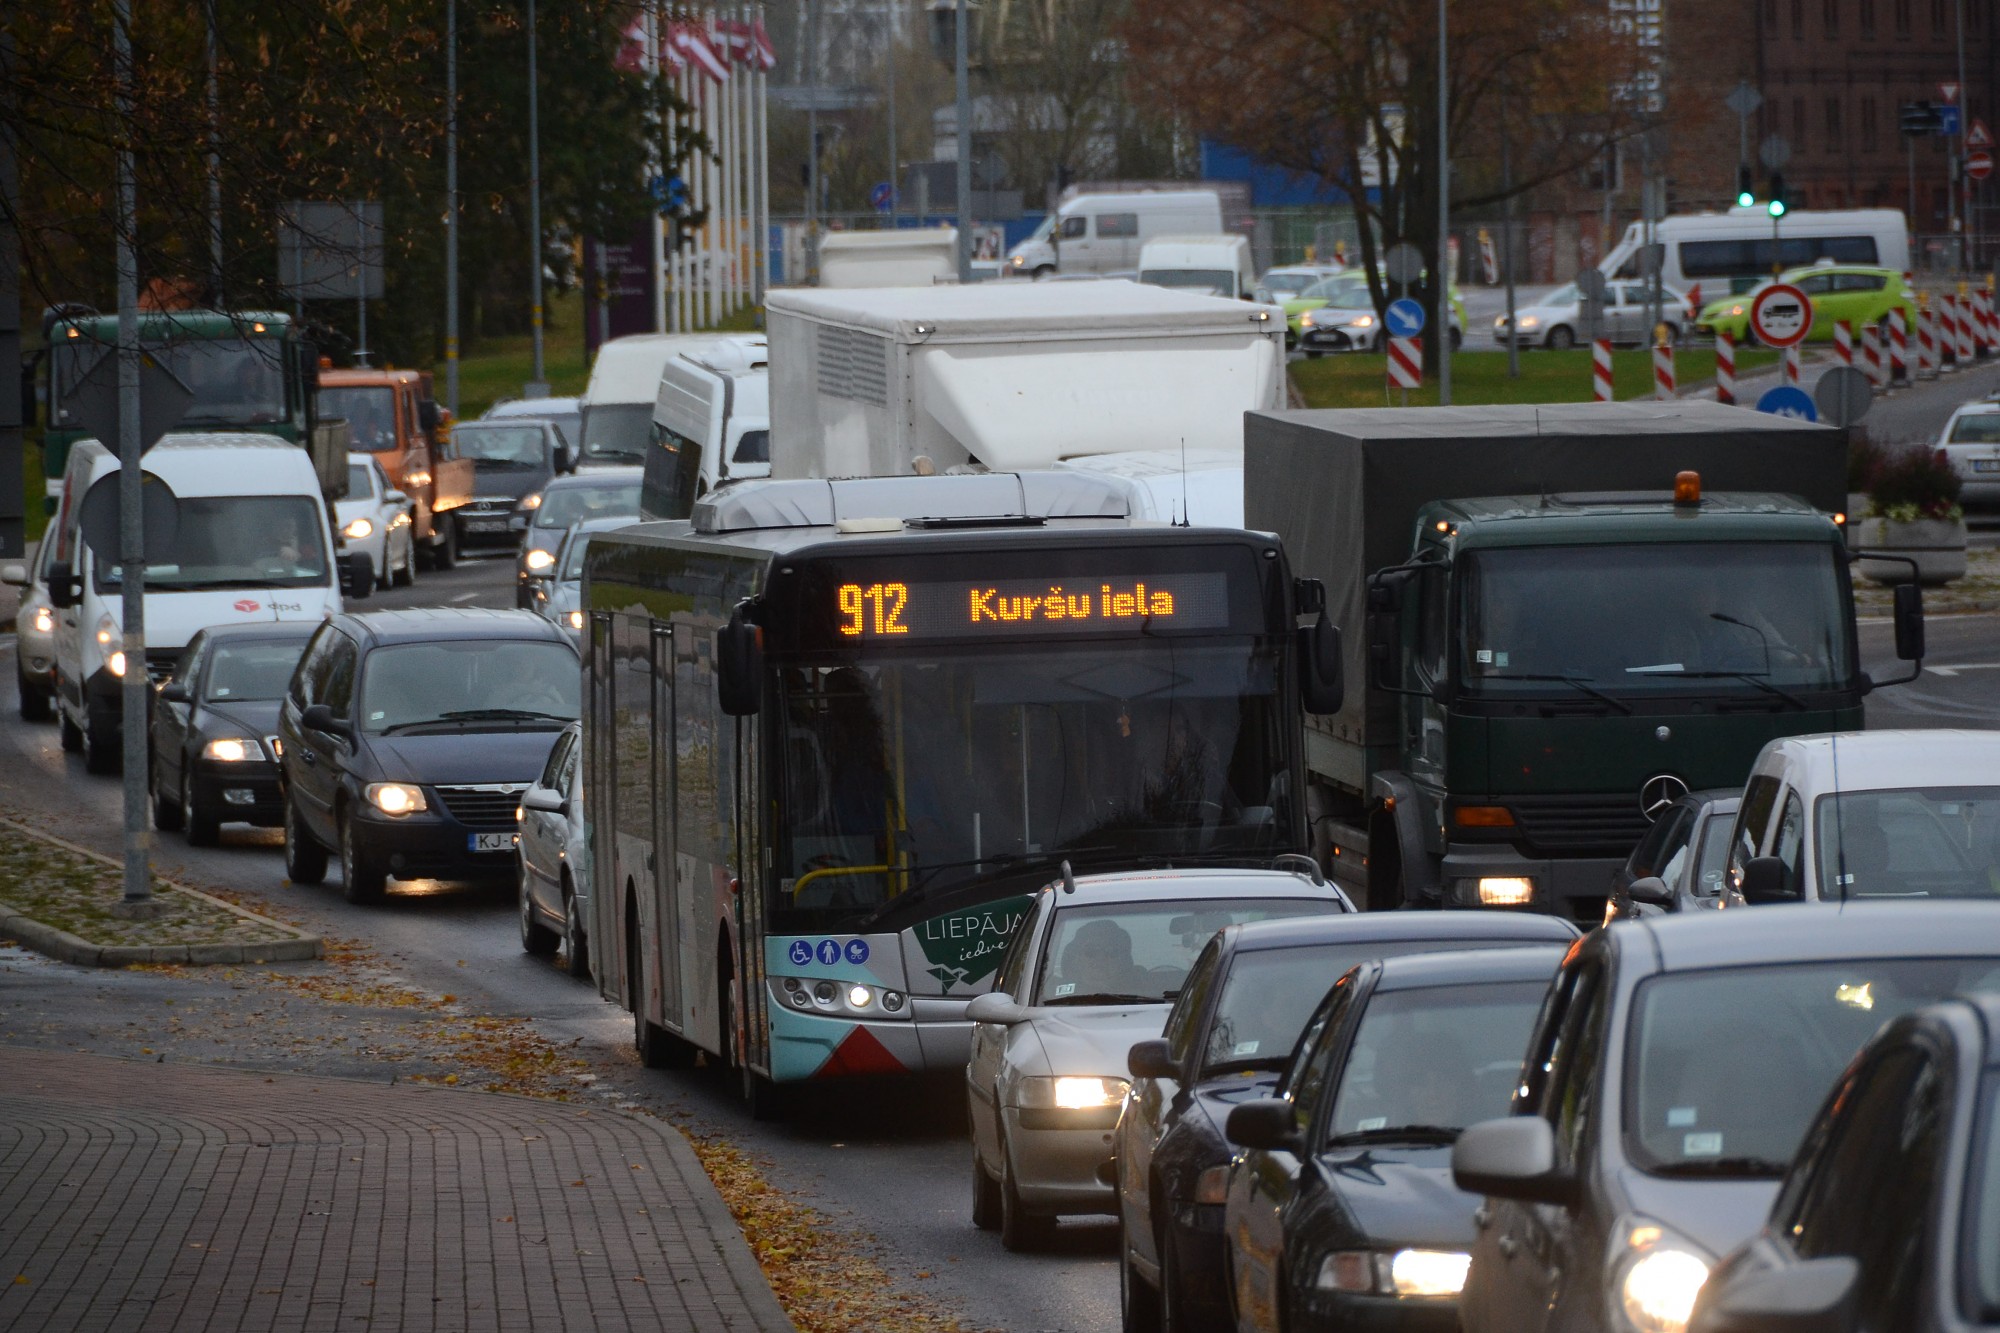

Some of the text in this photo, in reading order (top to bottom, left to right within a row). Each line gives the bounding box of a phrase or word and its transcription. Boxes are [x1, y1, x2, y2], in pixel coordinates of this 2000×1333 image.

[267, 602, 303, 611] dpd
[839, 583, 908, 635] 912
[971, 583, 1174, 622] Kuršu iela
